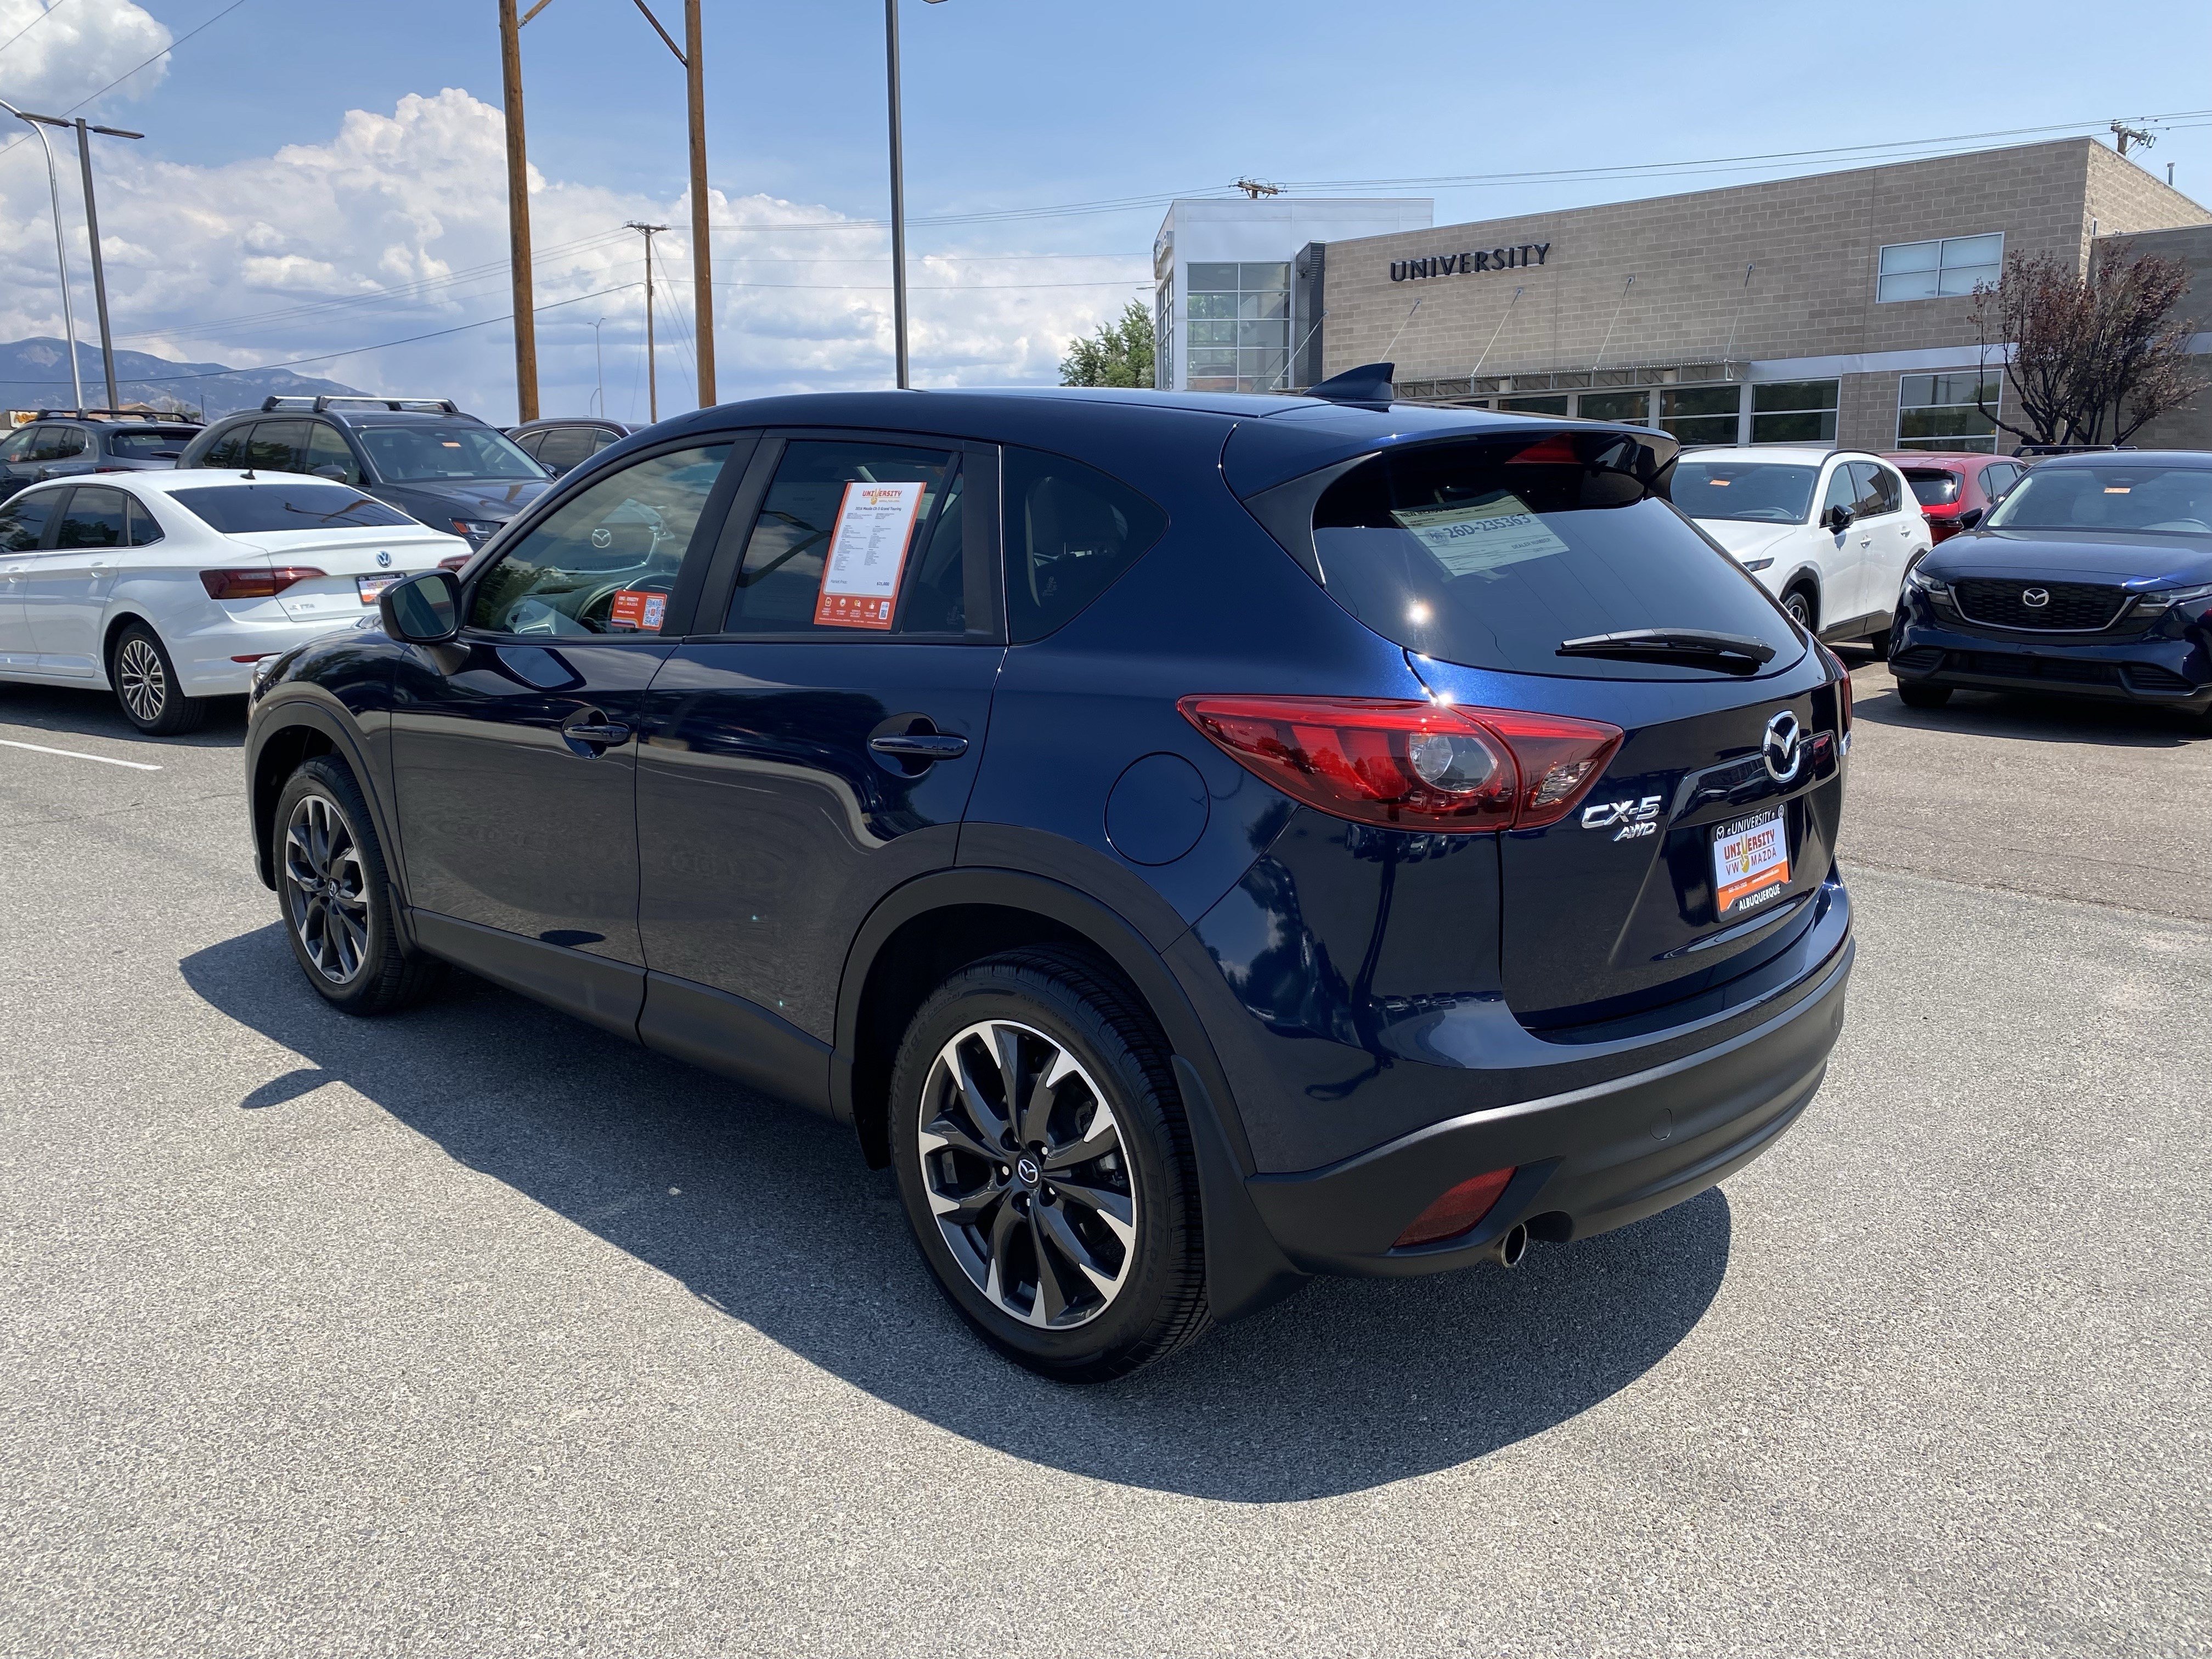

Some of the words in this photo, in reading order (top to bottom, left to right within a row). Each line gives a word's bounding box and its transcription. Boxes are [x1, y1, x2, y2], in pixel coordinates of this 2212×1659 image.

[1390, 242, 1551, 282] UNIVERSITY
[862, 488, 902, 497] UNIVERSITY
[1443, 513, 1532, 539] 26D-235363
[1581, 795, 1662, 829] CX-5
[1730, 809, 1772, 835] UNIVERSITY
[1612, 821, 1657, 842] AWD
[1724, 828, 1775, 860] UNIVERSITY
[1725, 861, 1739, 876] VW
[1751, 847, 1777, 867] MAZDA
[1738, 883, 1781, 912] ALBUQUERQUE
